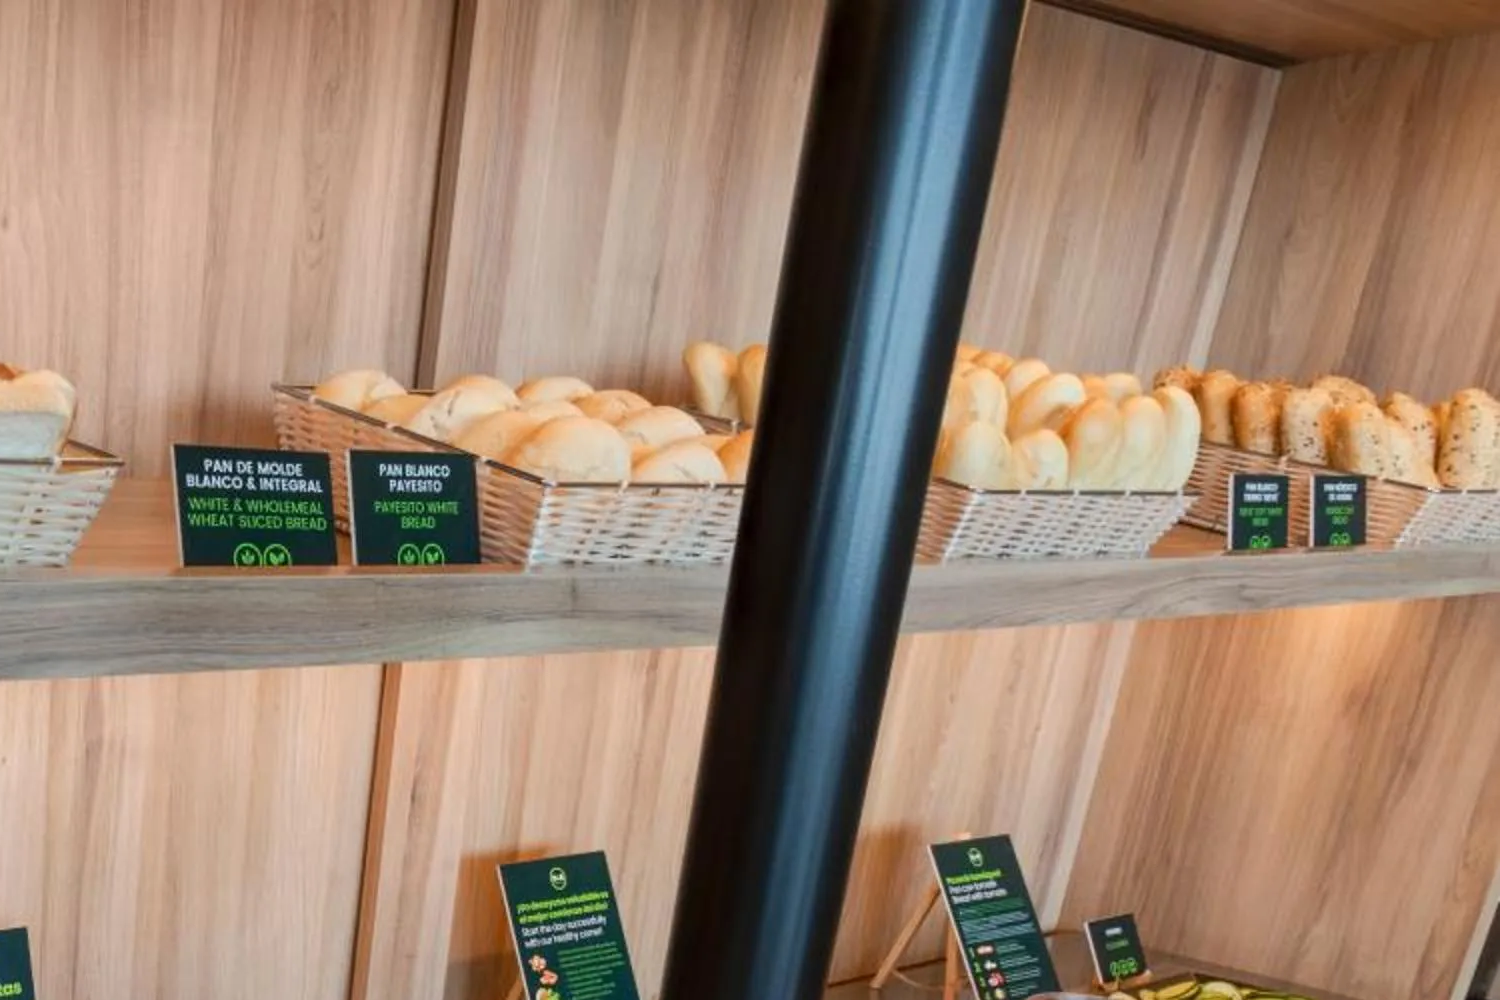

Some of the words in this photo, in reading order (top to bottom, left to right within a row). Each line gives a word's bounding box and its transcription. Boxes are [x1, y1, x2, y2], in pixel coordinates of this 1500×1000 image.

[203, 458, 233, 473] PAN
[236, 461, 254, 474] DE
[257, 462, 303, 477] MOLDE
[379, 464, 402, 477] PAN
[405, 464, 451, 478] BLANCO
[185, 473, 243, 489] BLANCO
[246, 476, 257, 490] &
[260, 478, 323, 493] INTEGRAL
[389, 480, 443, 493] PAYESITO
[188, 497, 229, 511] WHITE
[245, 499, 324, 515] WHOLEMEAL
[187, 512, 234, 527] WHEAT
[238, 515, 282, 529] SLICED
[285, 517, 327, 531] BREAD
[401, 516, 436, 529] BREAD
